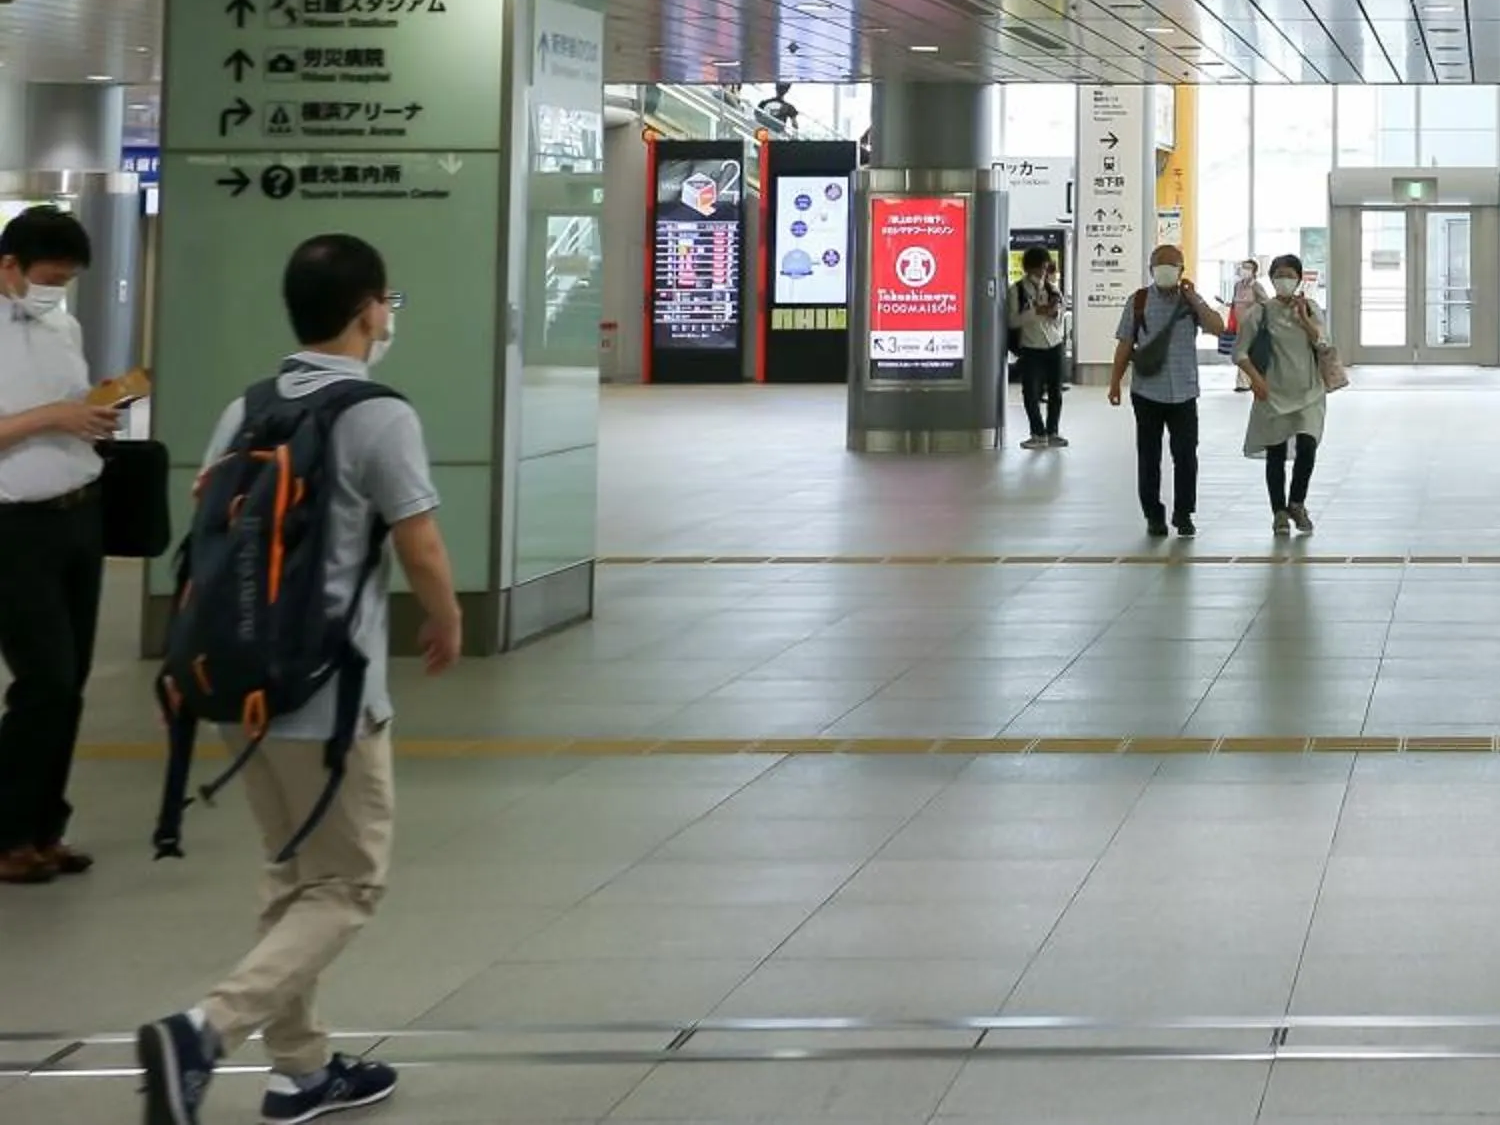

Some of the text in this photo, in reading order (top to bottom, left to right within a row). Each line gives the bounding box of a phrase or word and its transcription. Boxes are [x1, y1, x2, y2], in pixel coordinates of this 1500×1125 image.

[301, 101, 424, 122] 横浜アリーナ
